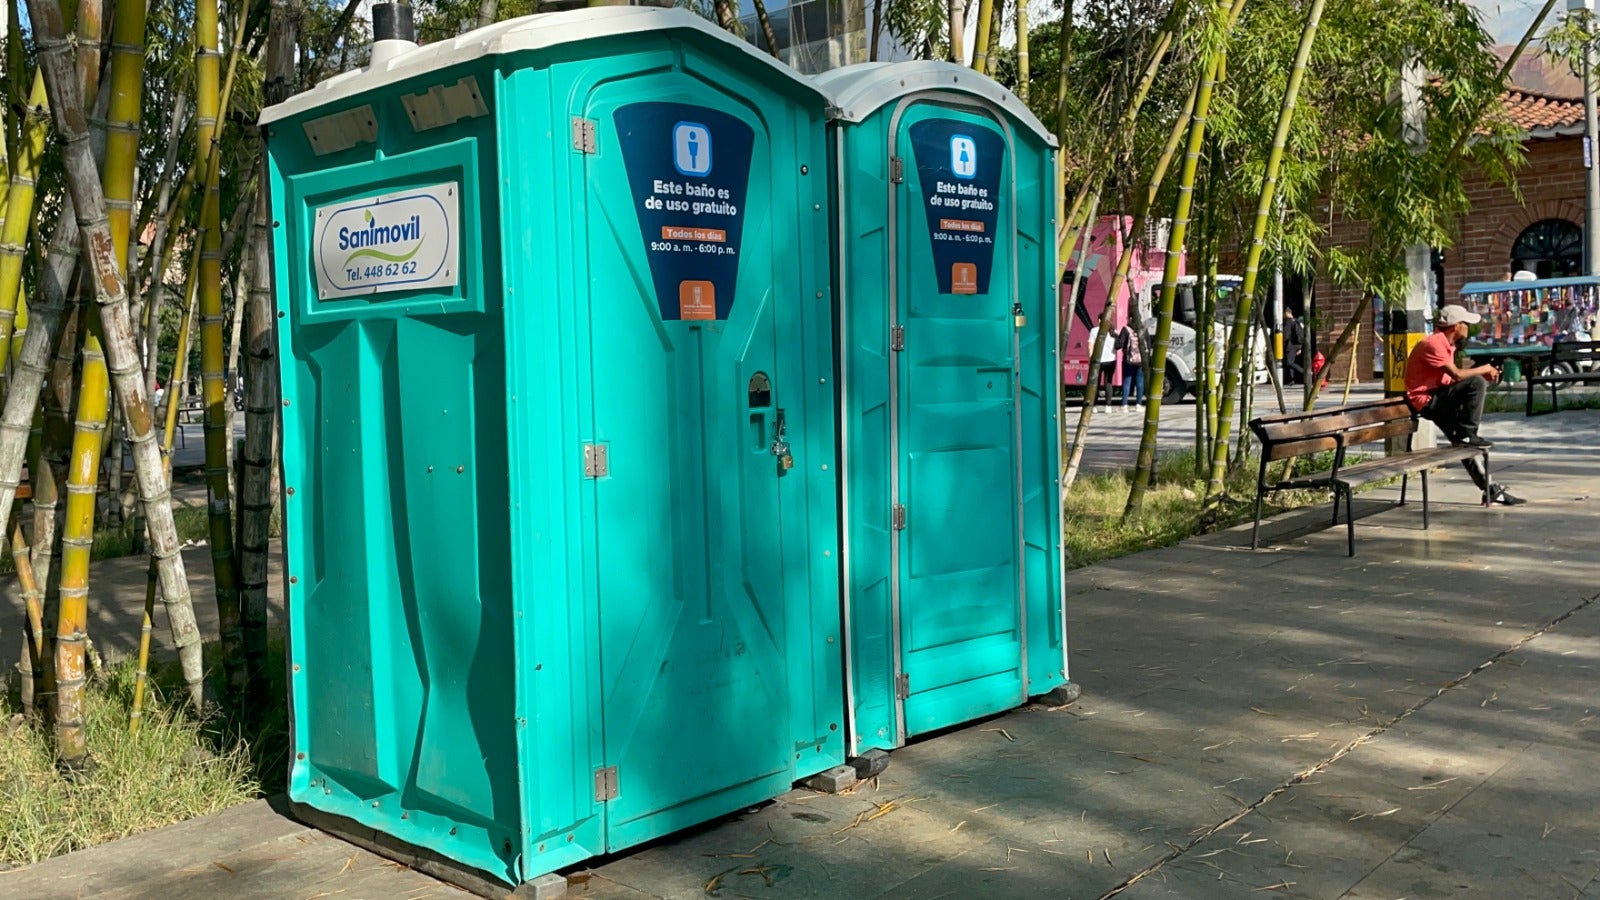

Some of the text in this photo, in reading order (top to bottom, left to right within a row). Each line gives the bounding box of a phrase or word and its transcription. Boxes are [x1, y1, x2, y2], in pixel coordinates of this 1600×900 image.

[653, 180, 730, 199] Este baño es
[936, 181, 988, 197] Este baño es
[645, 195, 737, 216] de uso gratuito
[930, 194, 994, 211] de uso gratuito
[339, 215, 420, 251] Sanimovil
[666, 228, 693, 239] Todos
[695, 231, 706, 239] los
[933, 232, 947, 241] 9:00
[965, 233, 978, 242] 6:00
[651, 241, 672, 251] 9:00
[673, 244, 681, 252] a.
[682, 244, 693, 253] m.
[699, 243, 717, 254] 6:00
[717, 246, 726, 256] p.
[726, 246, 736, 255] m.
[346, 261, 417, 281] Tel. 448 62 62
